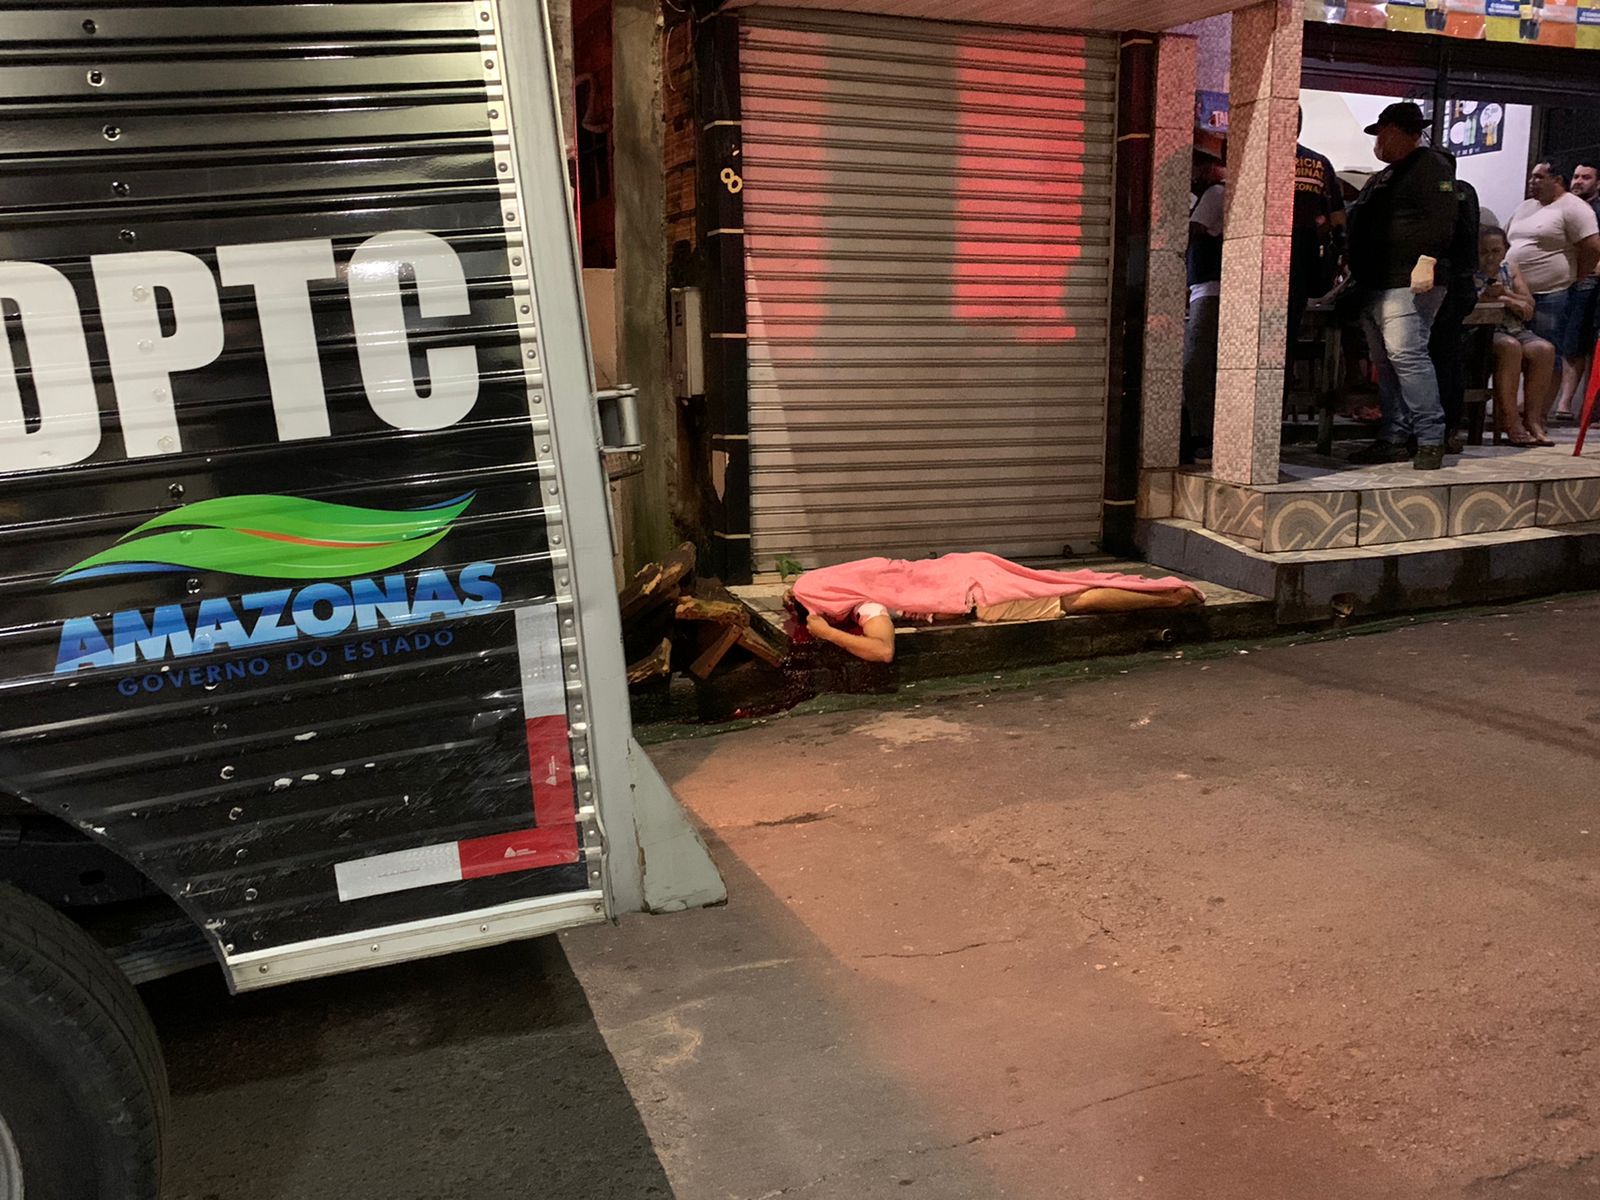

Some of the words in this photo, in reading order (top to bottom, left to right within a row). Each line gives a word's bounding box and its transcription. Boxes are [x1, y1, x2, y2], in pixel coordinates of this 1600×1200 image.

[0, 230, 480, 472] DPTC
[54, 562, 503, 677] AMAZONAS
[117, 658, 270, 696] GOVERNO
[286, 648, 328, 671] DO
[344, 630, 455, 662] ESTADO
